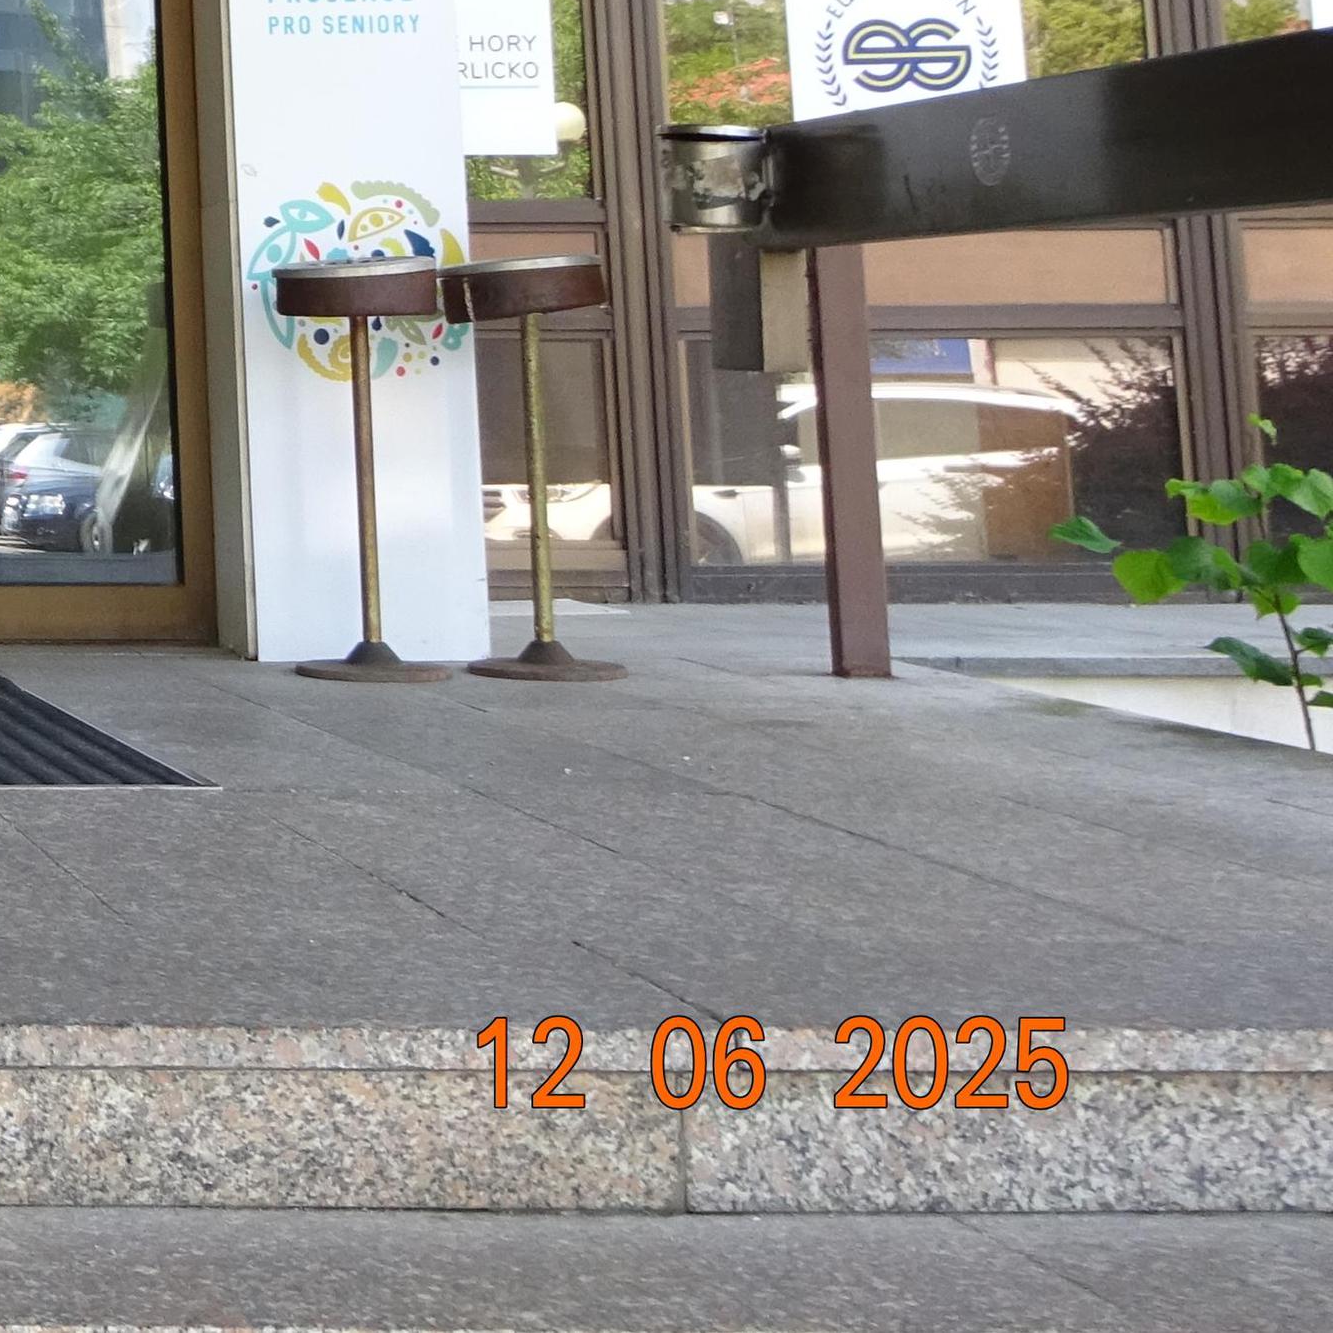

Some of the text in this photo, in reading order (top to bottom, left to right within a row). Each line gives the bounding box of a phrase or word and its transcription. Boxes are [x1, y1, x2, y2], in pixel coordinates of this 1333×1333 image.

[268, 14, 420, 36] PRO SENIORY
[469, 34, 537, 52] HORY
[458, 61, 539, 79] RLICKO
